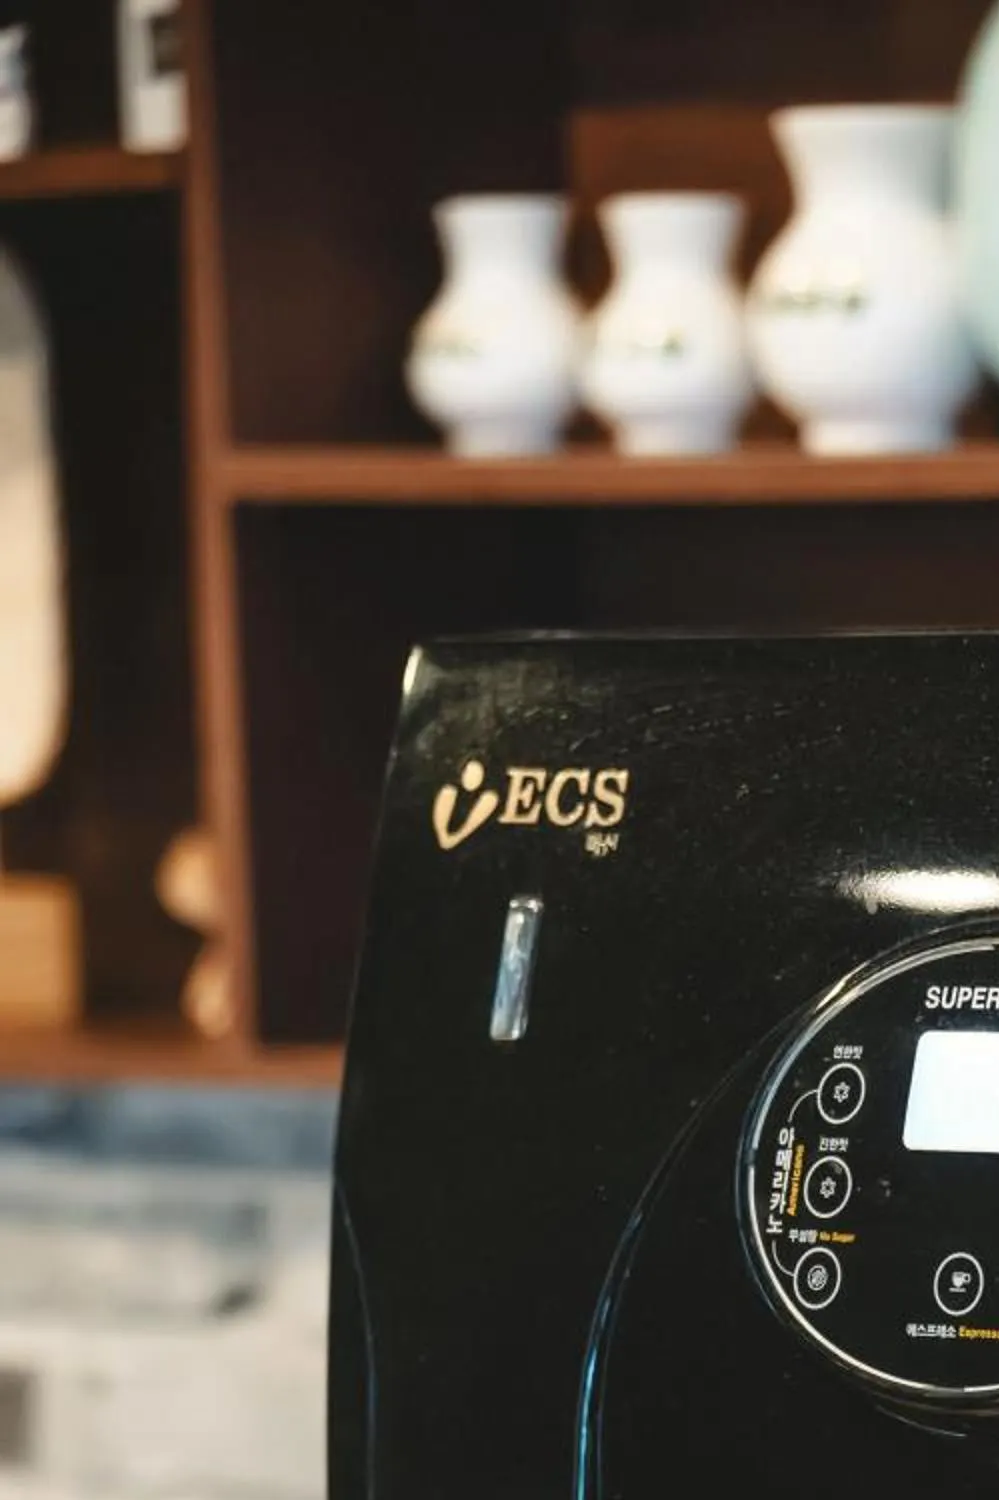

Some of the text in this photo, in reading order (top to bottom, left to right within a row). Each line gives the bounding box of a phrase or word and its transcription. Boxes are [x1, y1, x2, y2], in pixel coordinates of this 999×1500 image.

[497, 767, 629, 827] ECS
[766, 1127, 795, 1233] 아메리카노
[906, 1323, 957, 1338] 에스프레소
